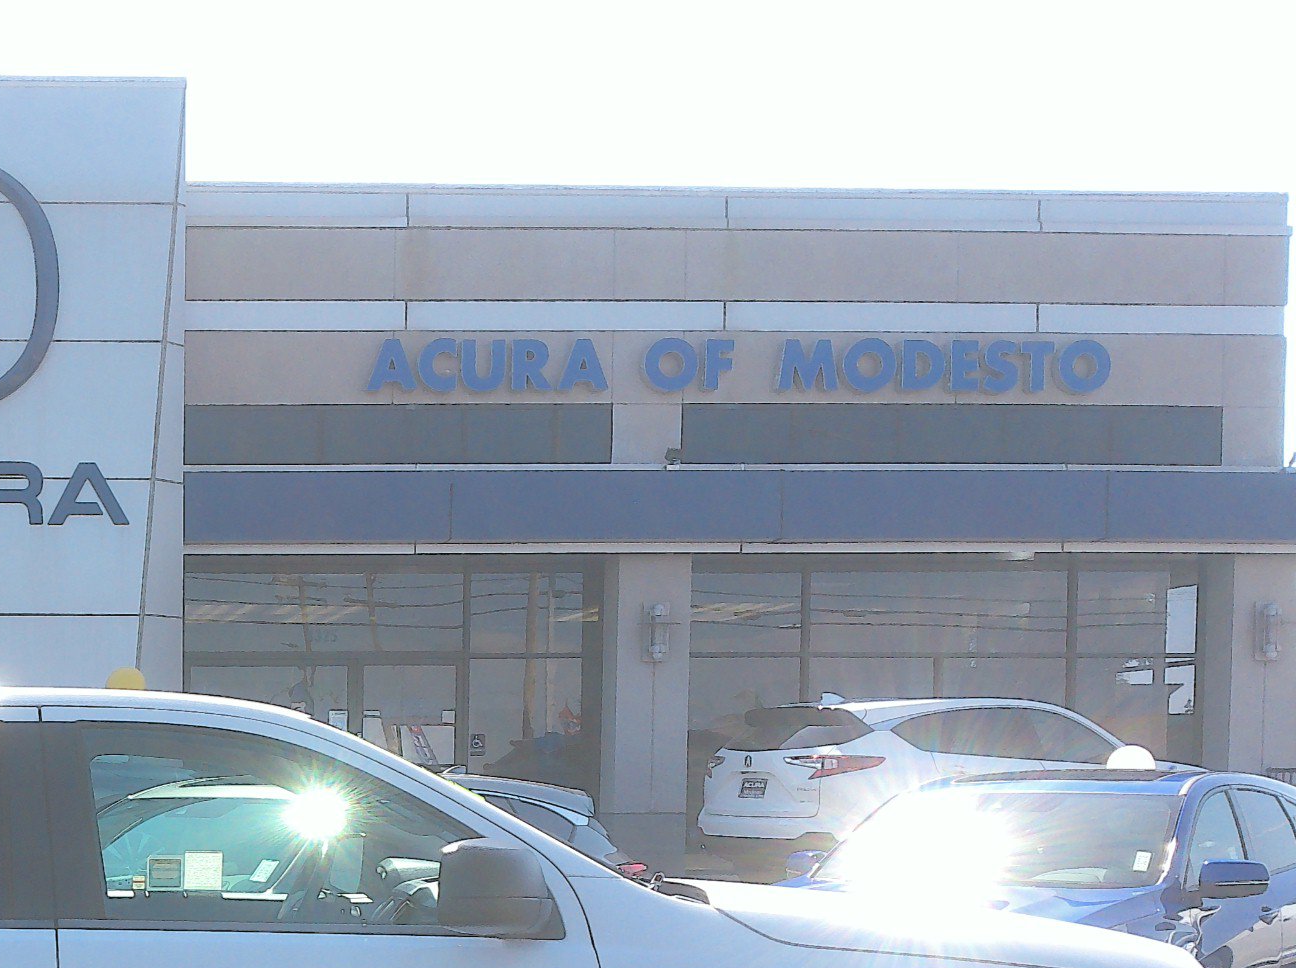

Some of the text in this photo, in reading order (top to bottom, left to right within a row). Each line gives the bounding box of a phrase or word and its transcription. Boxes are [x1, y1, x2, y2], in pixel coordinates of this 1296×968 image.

[365, 337, 1111, 394] ACURA OF MODESTO
